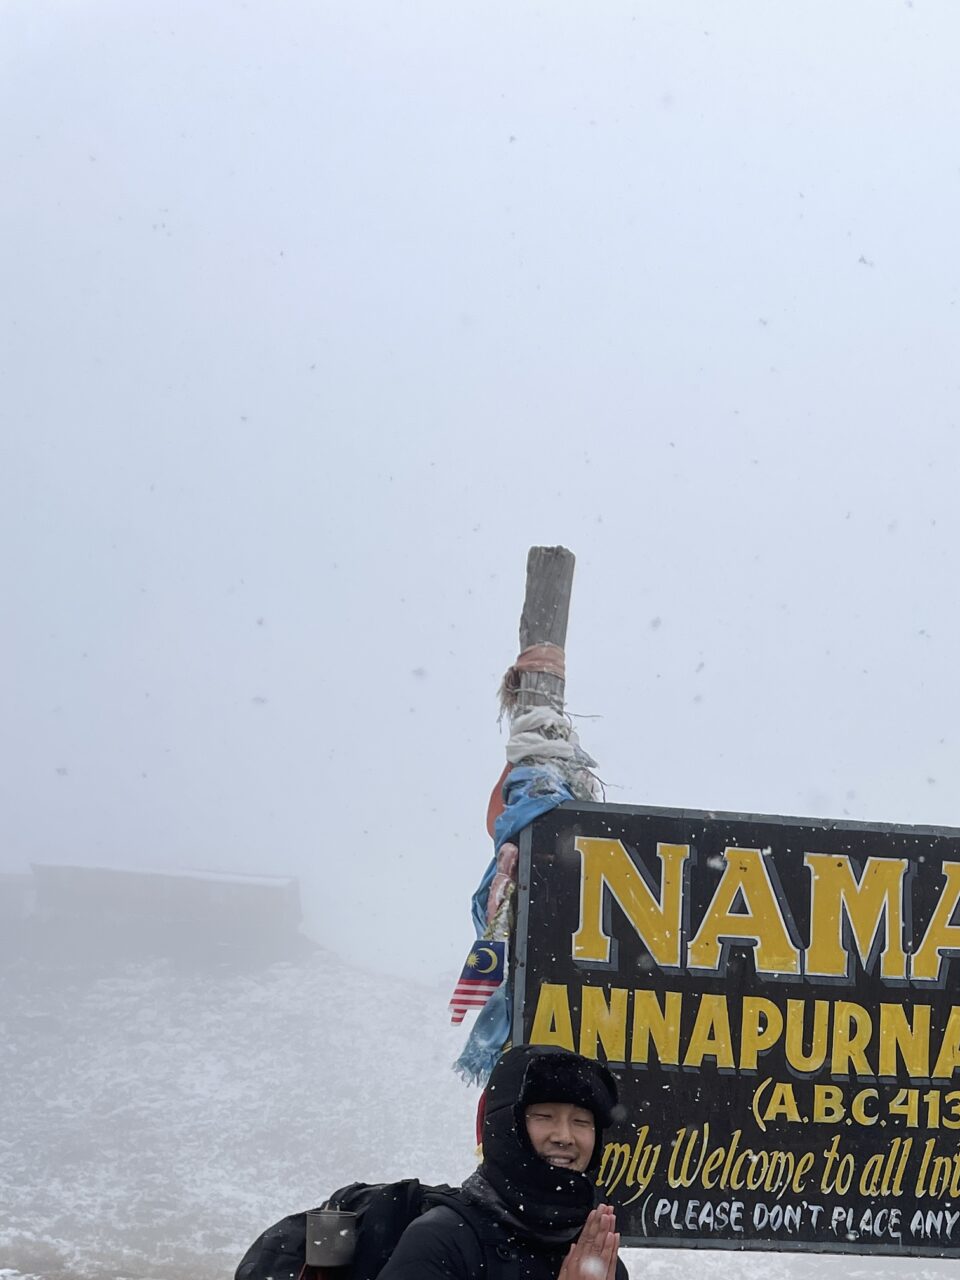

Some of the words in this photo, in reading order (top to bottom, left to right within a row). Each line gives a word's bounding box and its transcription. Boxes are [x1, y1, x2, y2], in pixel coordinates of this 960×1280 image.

[595, 1125, 662, 1206] mly
[667, 1122, 815, 1200] Welcome
[820, 1134, 855, 1196] to
[859, 1136, 914, 1197] all
[640, 1192, 745, 1237] (PLEASE
[752, 1200, 824, 1234] DON'T
[831, 1205, 903, 1240] PLACE
[909, 1208, 960, 1240] ANY
